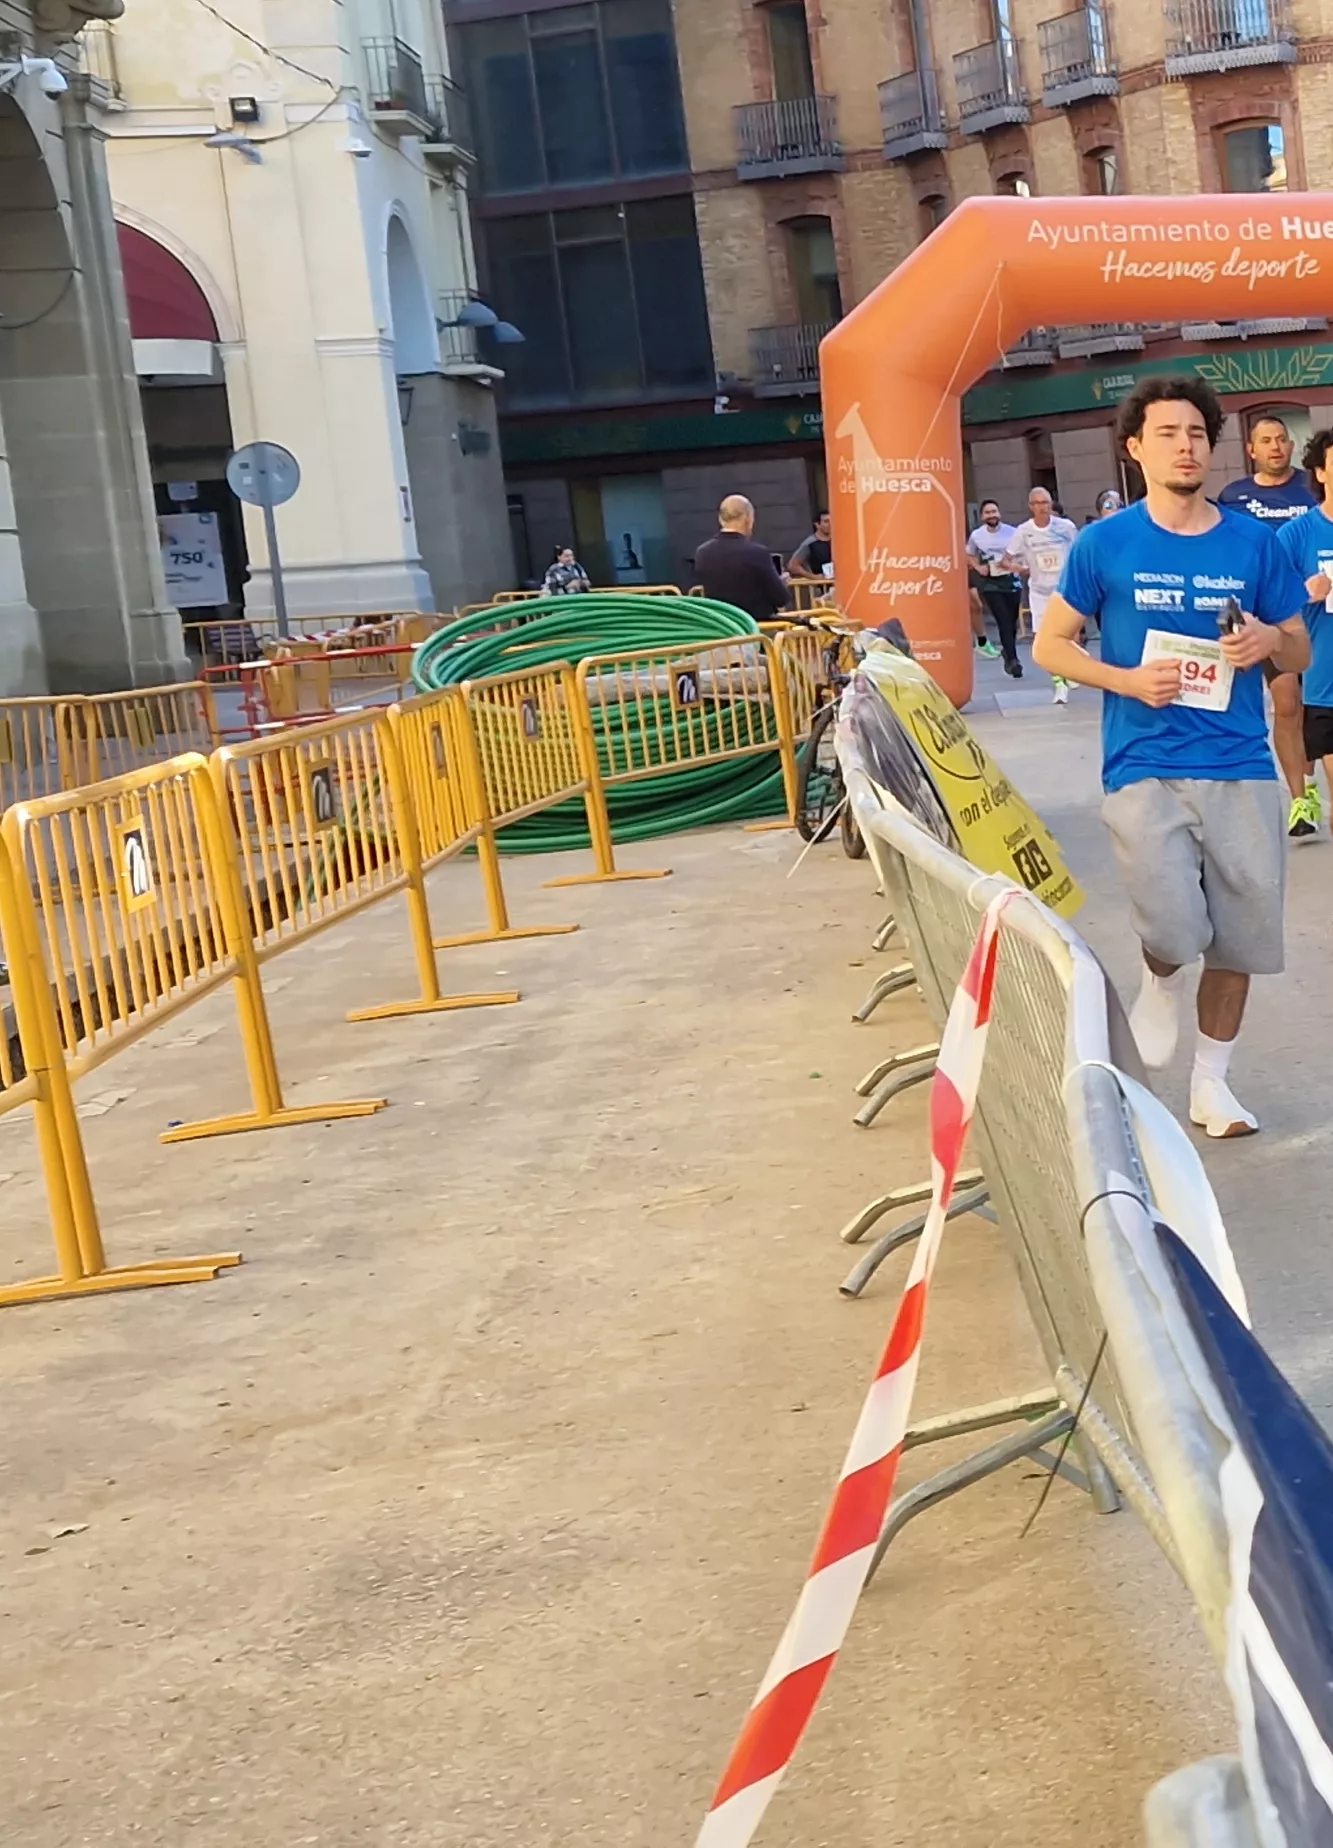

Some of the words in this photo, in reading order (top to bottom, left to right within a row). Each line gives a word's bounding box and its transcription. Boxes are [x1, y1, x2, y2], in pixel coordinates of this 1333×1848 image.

[1027, 218, 1231, 249] Ayuntamiento
[1238, 217, 1272, 241] de
[1100, 248, 1216, 283] Hacemos
[1221, 247, 1320, 290] deporte
[840, 476, 855, 494] de
[861, 476, 932, 493] Huesca
[867, 546, 951, 572] Hacemos
[869, 574, 944, 606] deporte
[1134, 588, 1185, 604] NEXT
[1180, 659, 1218, 684] 94
[960, 804, 981, 828] con
[981, 787, 993, 815] el
